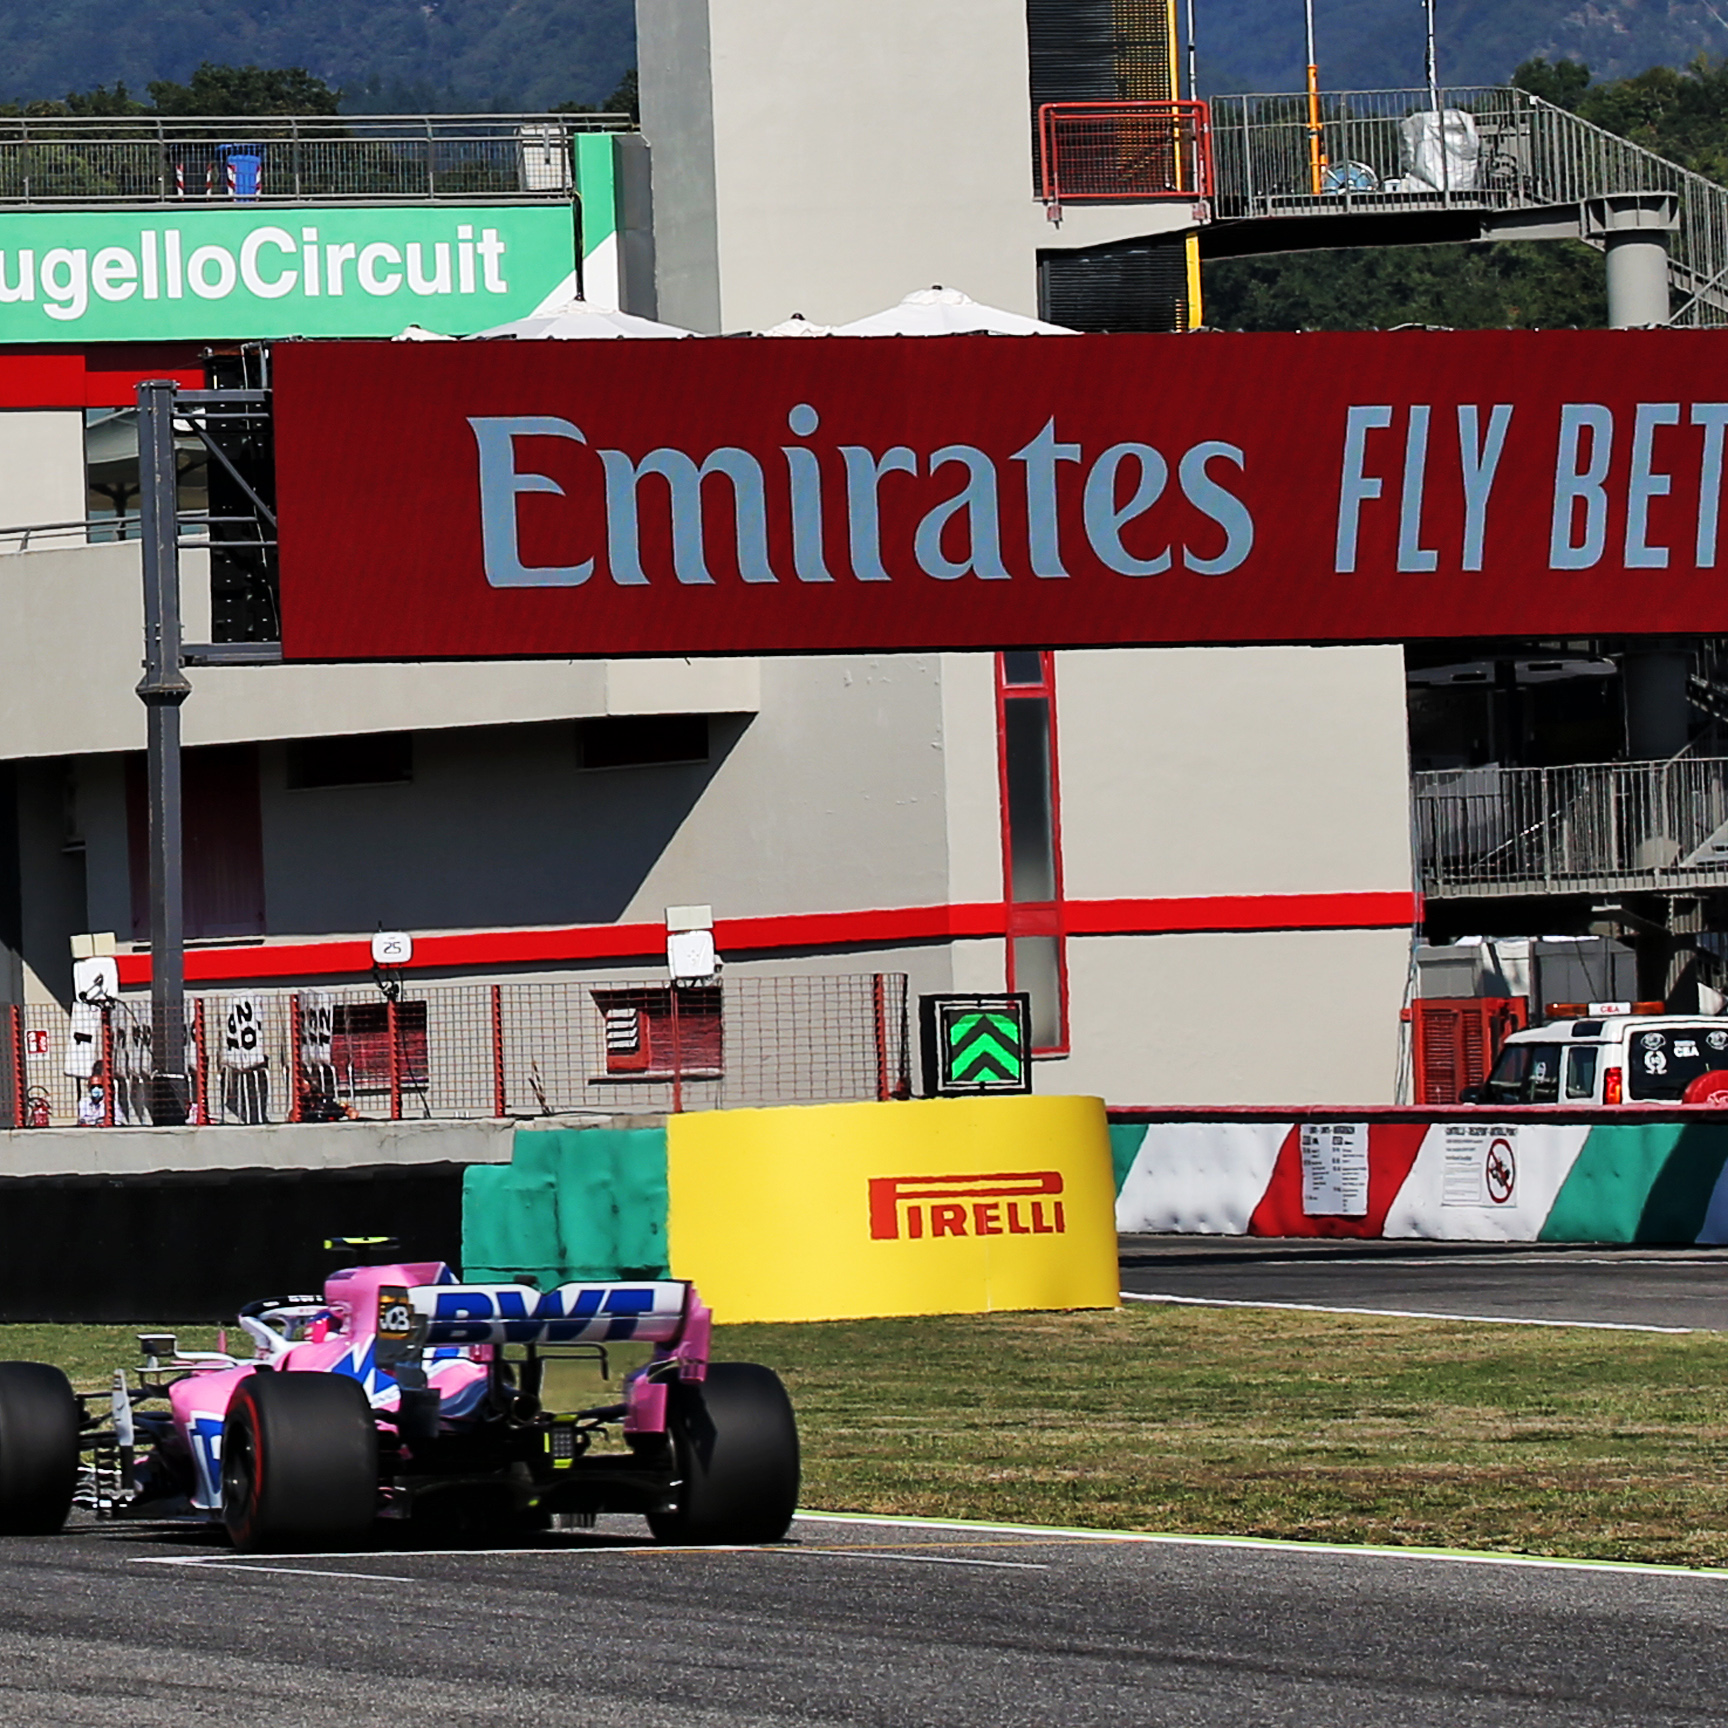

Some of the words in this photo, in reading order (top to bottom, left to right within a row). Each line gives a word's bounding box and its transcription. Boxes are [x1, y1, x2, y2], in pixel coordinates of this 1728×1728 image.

[466, 402, 1255, 589] Emirates
[1335, 403, 1515, 574] FLY
[868, 1171, 1065, 1240] PIRELLI
[428, 1288, 655, 1343] BWT
